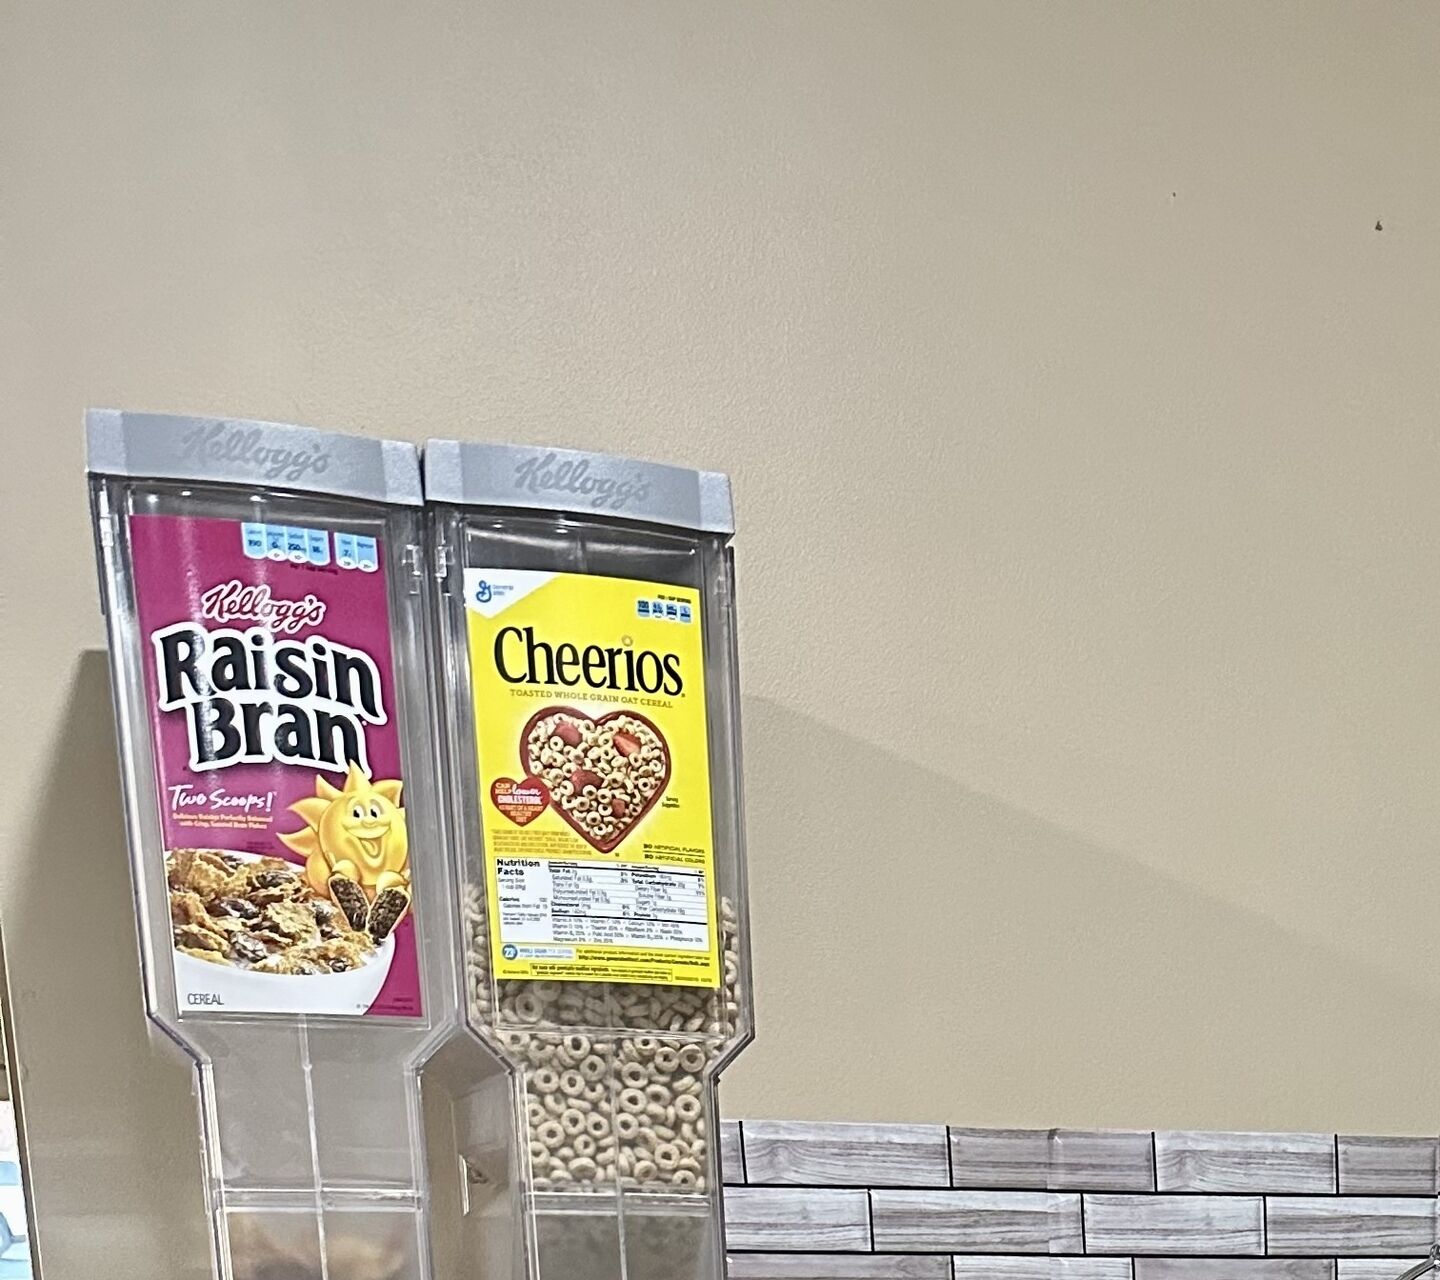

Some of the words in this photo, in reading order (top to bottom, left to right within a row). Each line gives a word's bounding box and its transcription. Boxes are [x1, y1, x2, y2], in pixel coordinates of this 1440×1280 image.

[182, 421, 329, 480] Kellogg's
[513, 452, 651, 509] Kellogg's
[203, 582, 324, 631] Kellogg's
[160, 629, 380, 717] Raisin
[494, 626, 684, 696] Cheerios
[510, 689, 552, 698] TOASTED
[554, 691, 588, 700] WHOLE
[590, 694, 619, 703] GRAIN
[621, 696, 638, 705] OAT
[640, 698, 673, 708] CEREAL
[192, 697, 366, 775] Bran
[168, 784, 207, 811] Two
[210, 788, 273, 812] Scoops!
[497, 859, 540, 868] Nutrition
[497, 867, 525, 876] Facts
[187, 994, 224, 1006] CEREAL
